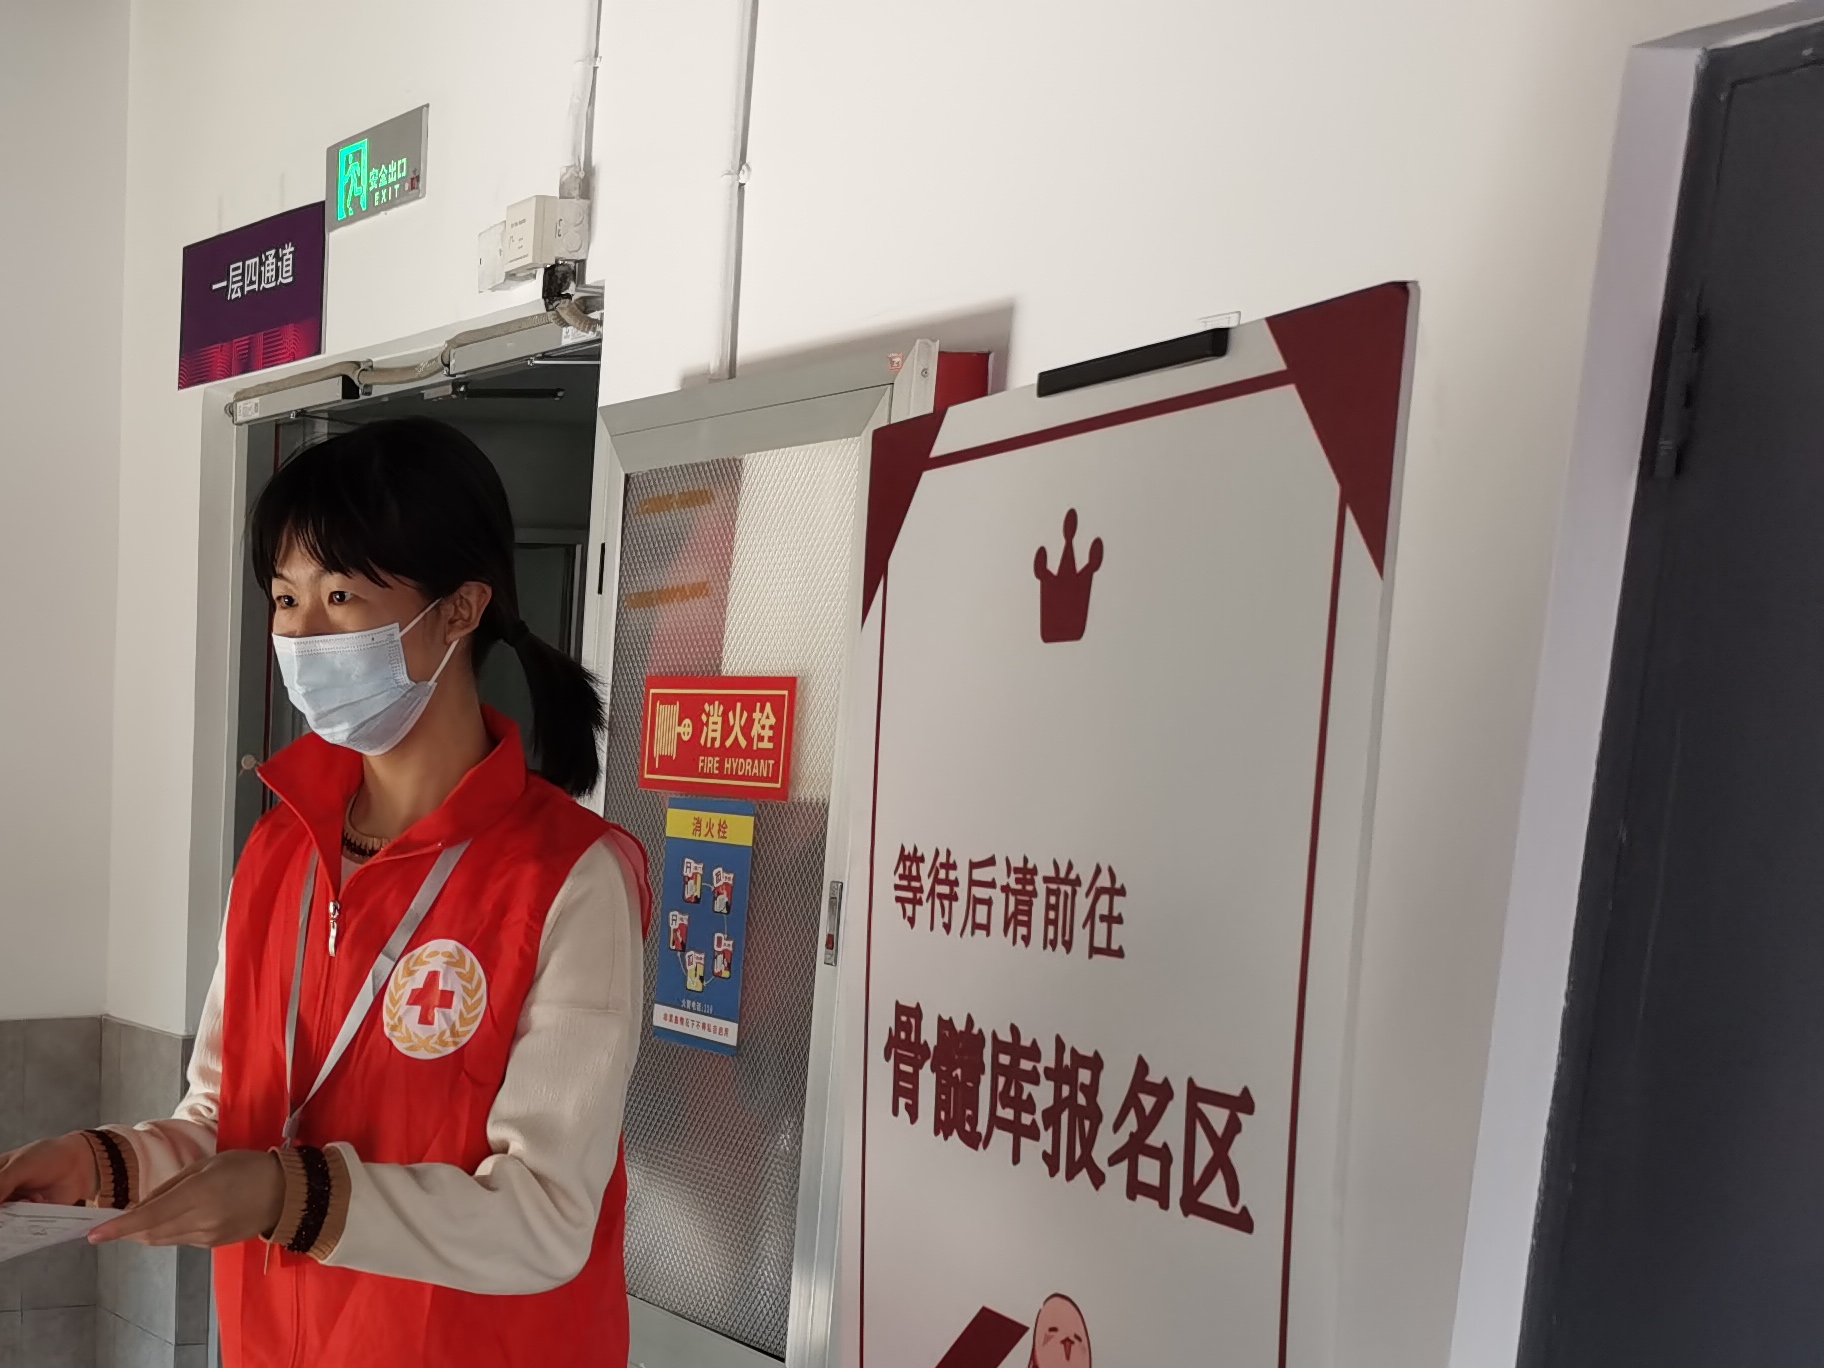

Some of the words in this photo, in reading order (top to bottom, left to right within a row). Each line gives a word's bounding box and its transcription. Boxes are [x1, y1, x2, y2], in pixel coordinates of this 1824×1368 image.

[369, 157, 407, 191] 安全出口
[374, 184, 400, 206] EXIT
[211, 242, 295, 302] 一层四通道
[699, 701, 777, 750] 消火栓
[698, 756, 719, 774] FIRE
[724, 757, 775, 778] HYDRANT
[691, 816, 729, 840] 消火栓
[893, 843, 1127, 960] 等待后请前往
[884, 999, 1255, 1235] 骨髓库报名区
